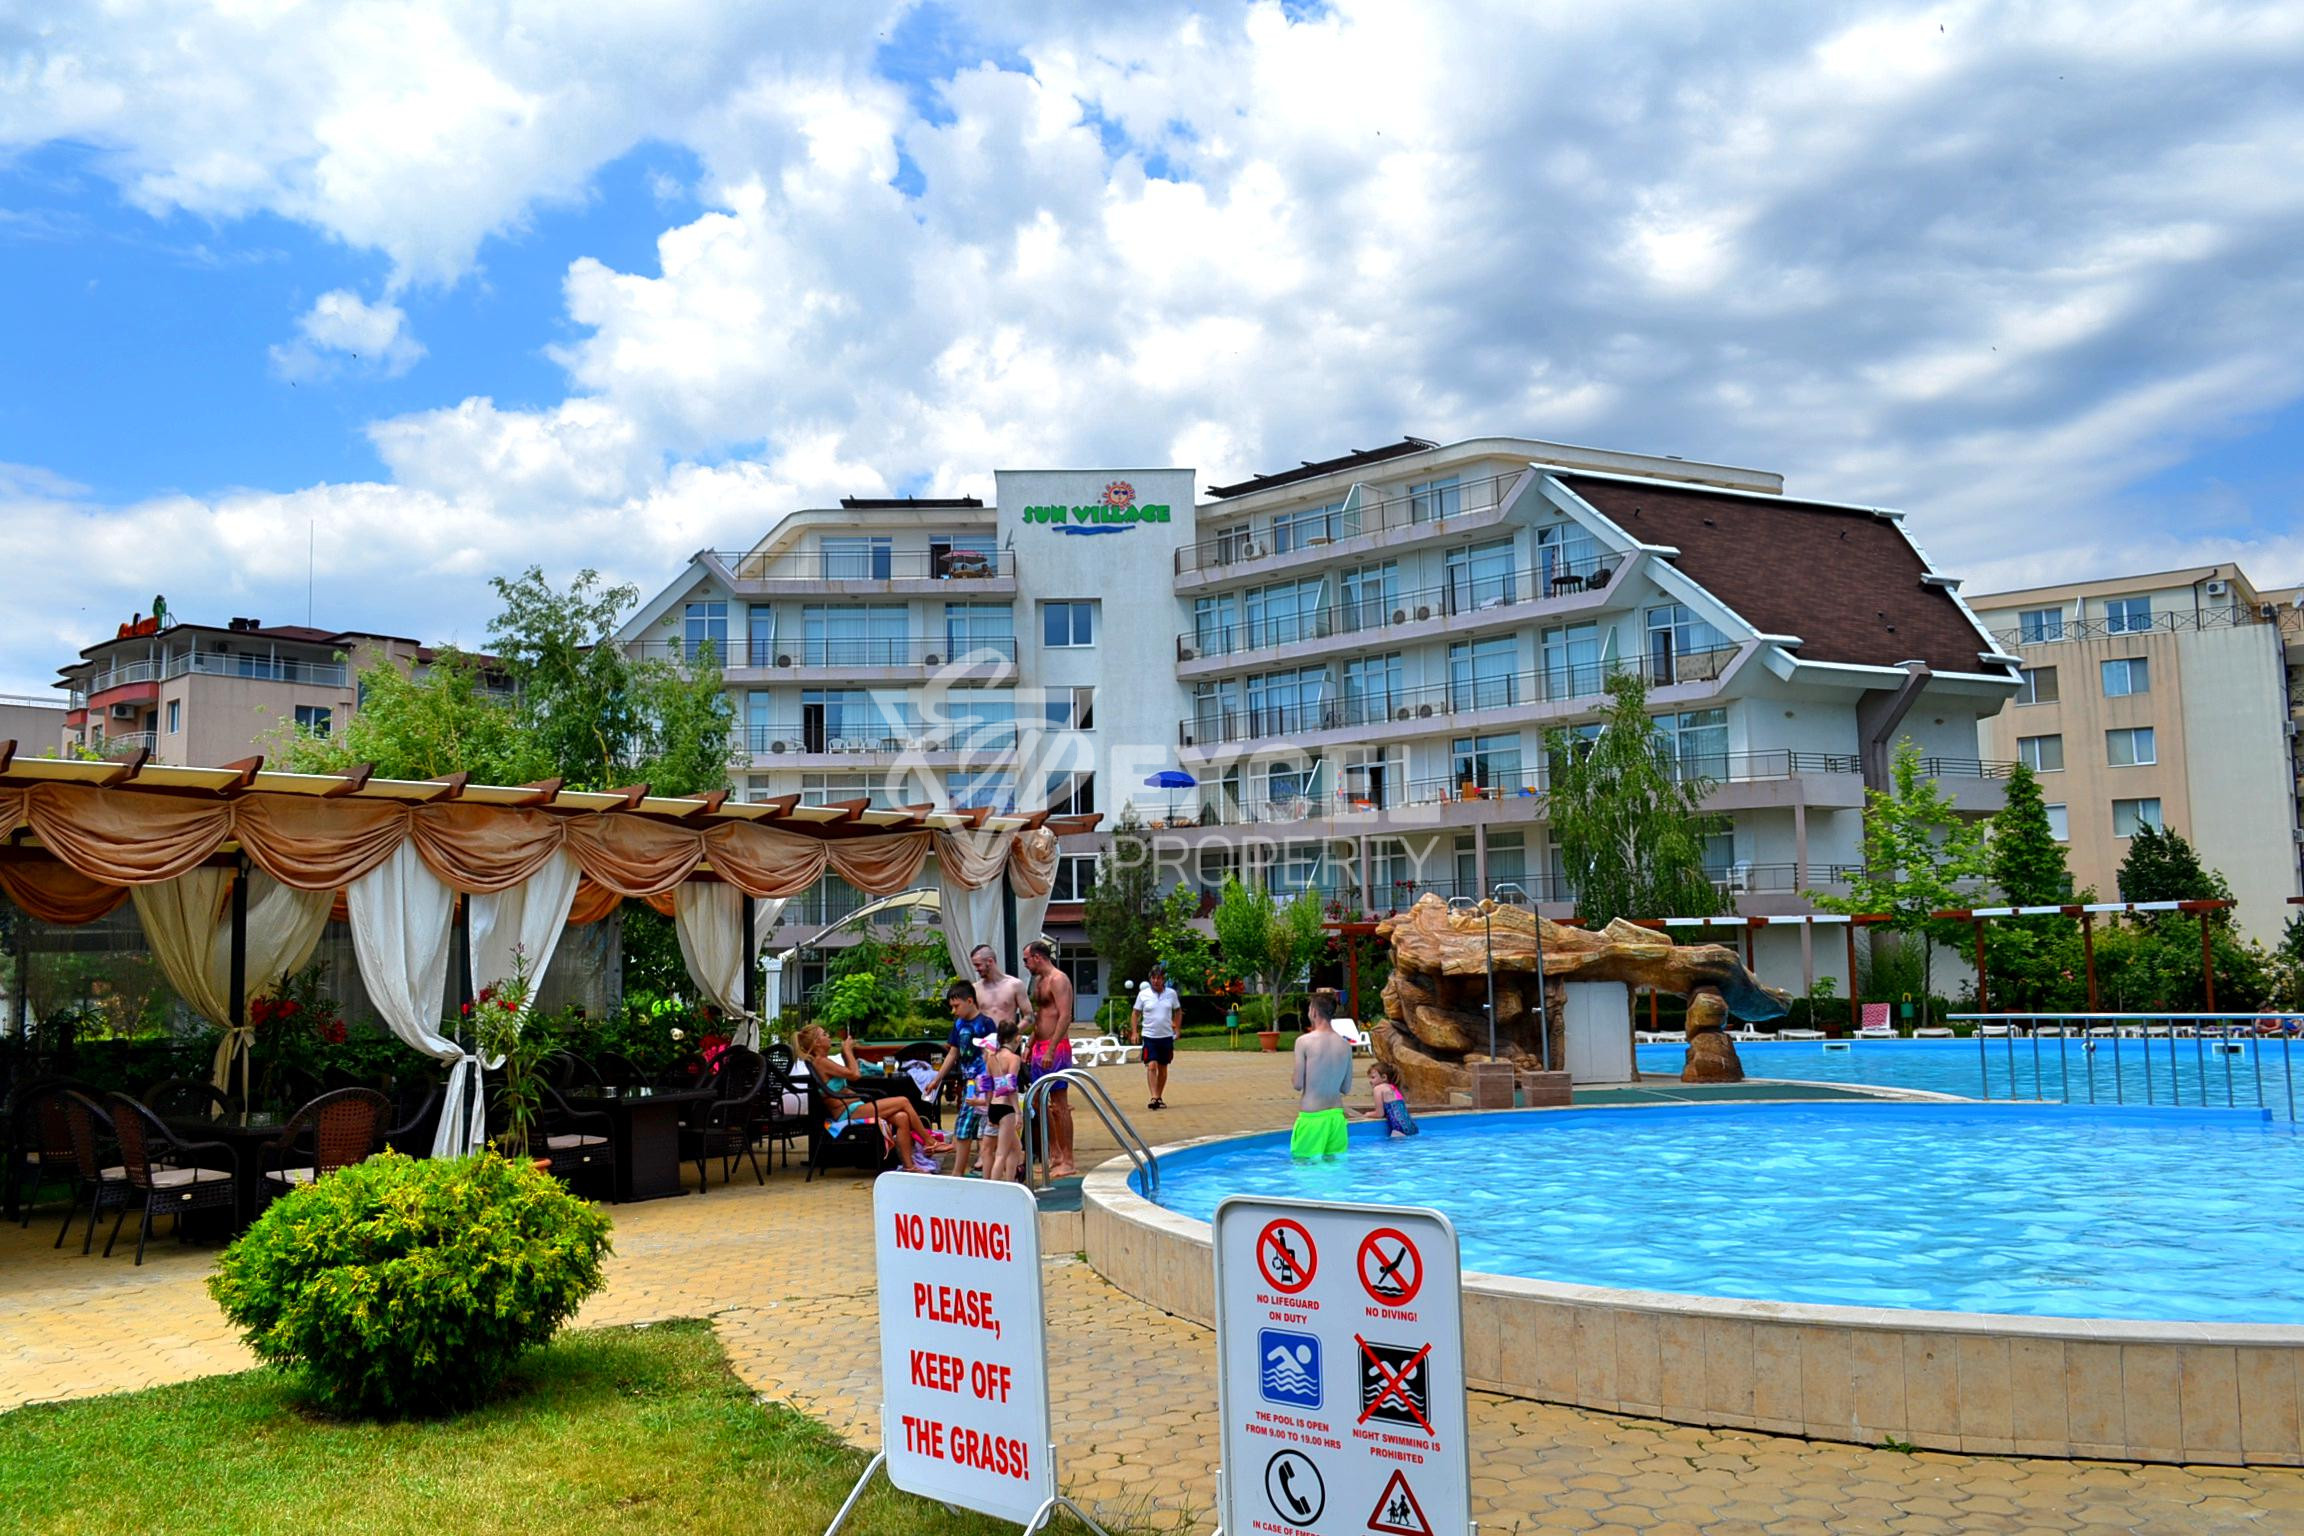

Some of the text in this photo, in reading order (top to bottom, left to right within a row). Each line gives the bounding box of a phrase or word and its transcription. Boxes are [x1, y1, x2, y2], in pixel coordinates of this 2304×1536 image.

[1022, 504, 1171, 524] SUN VILLAGE
[894, 1213, 1012, 1262] NO DIVING!
[914, 1282, 1001, 1340] PLEASE,
[1256, 1294, 1320, 1310] NO LIFEGUARD
[1269, 1311, 1307, 1324] ON DUTY
[1365, 1306, 1418, 1322] NO DIVING!
[910, 1350, 1012, 1403] KEEP OFF
[1256, 1411, 1329, 1432] THE POOL IS OPEN
[1245, 1423, 1342, 1450] FROM 9.00 TO 19.00 HRS
[1352, 1428, 1441, 1452] NIGHT SWIMMING IS
[902, 1415, 1030, 1481] THE GRASS!
[1369, 1446, 1424, 1464] PROHIBITED
[1252, 1520, 1261, 1529] IN
[1262, 1522, 1282, 1533] CASE
[1283, 1527, 1294, 1536] OF
